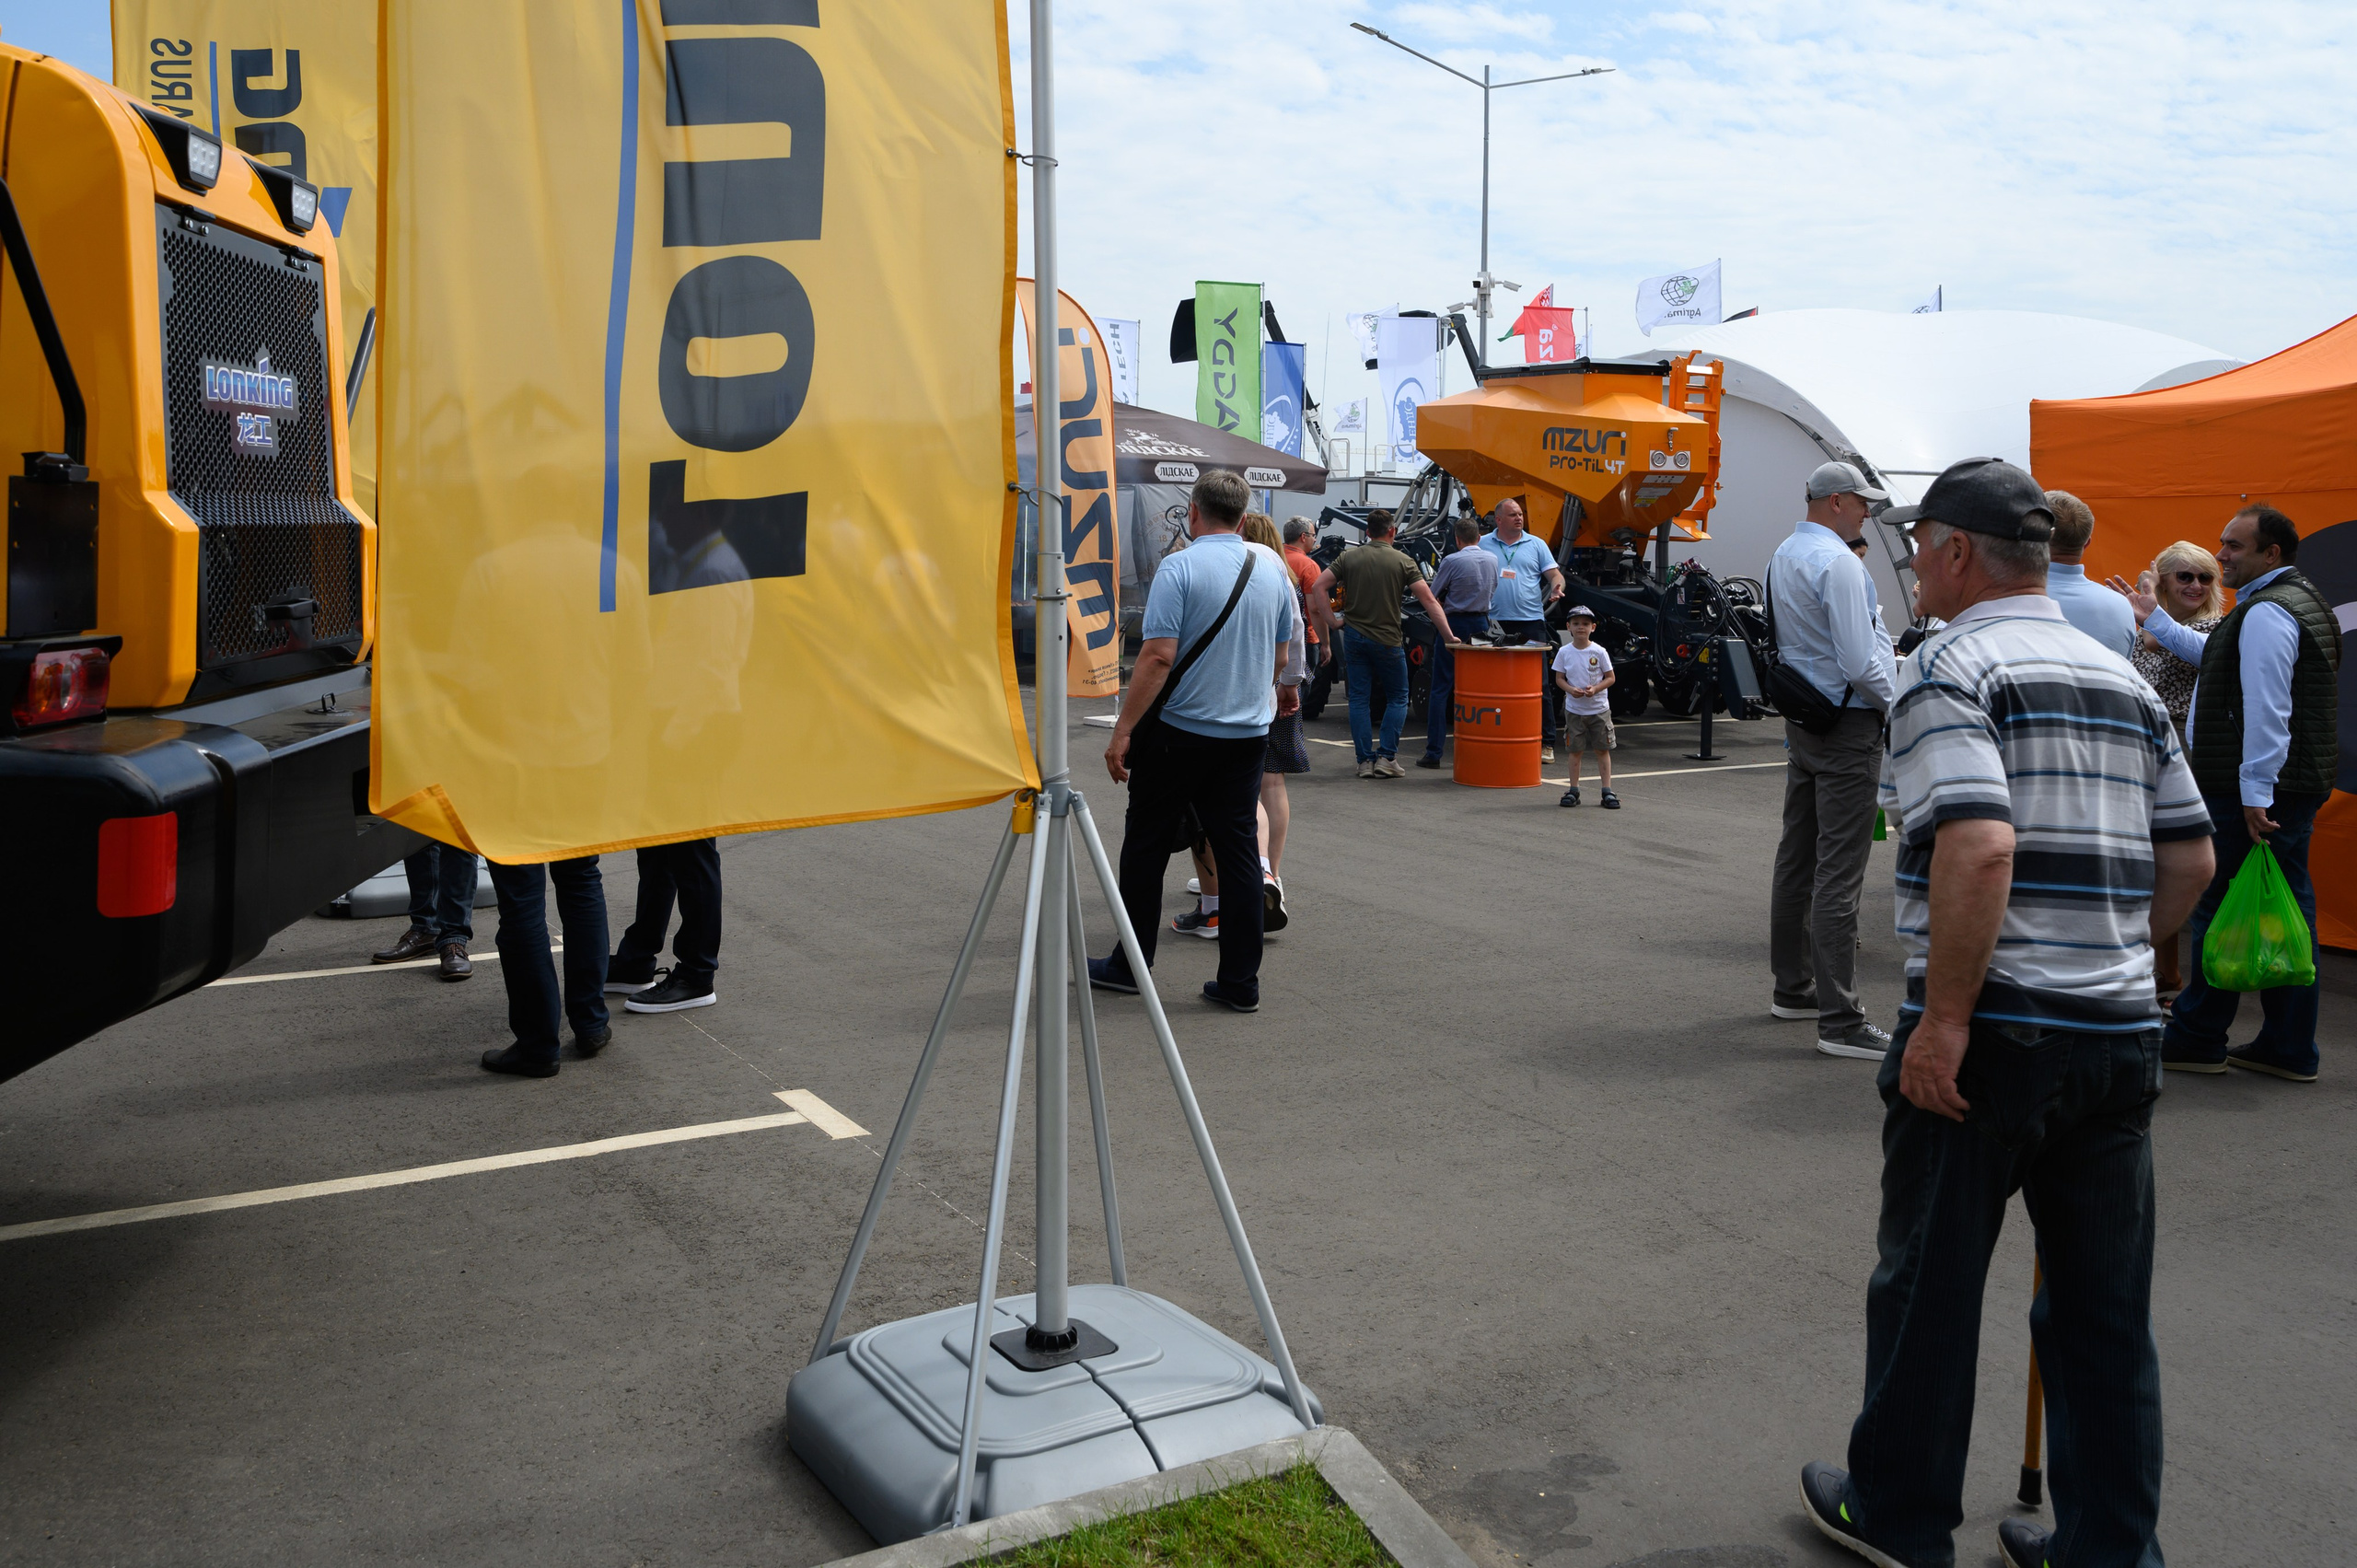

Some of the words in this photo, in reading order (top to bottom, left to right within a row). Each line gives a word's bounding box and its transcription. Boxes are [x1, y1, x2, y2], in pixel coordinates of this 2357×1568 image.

[237, 412, 273, 447] 龙工
[1116, 444, 1211, 458] ЛІДСКАЕ
[1160, 467, 1195, 477] ЛІДСКАЕ
[1248, 471, 1282, 482] ЛІДСКАЕ
[1455, 703, 1502, 726] zuri
